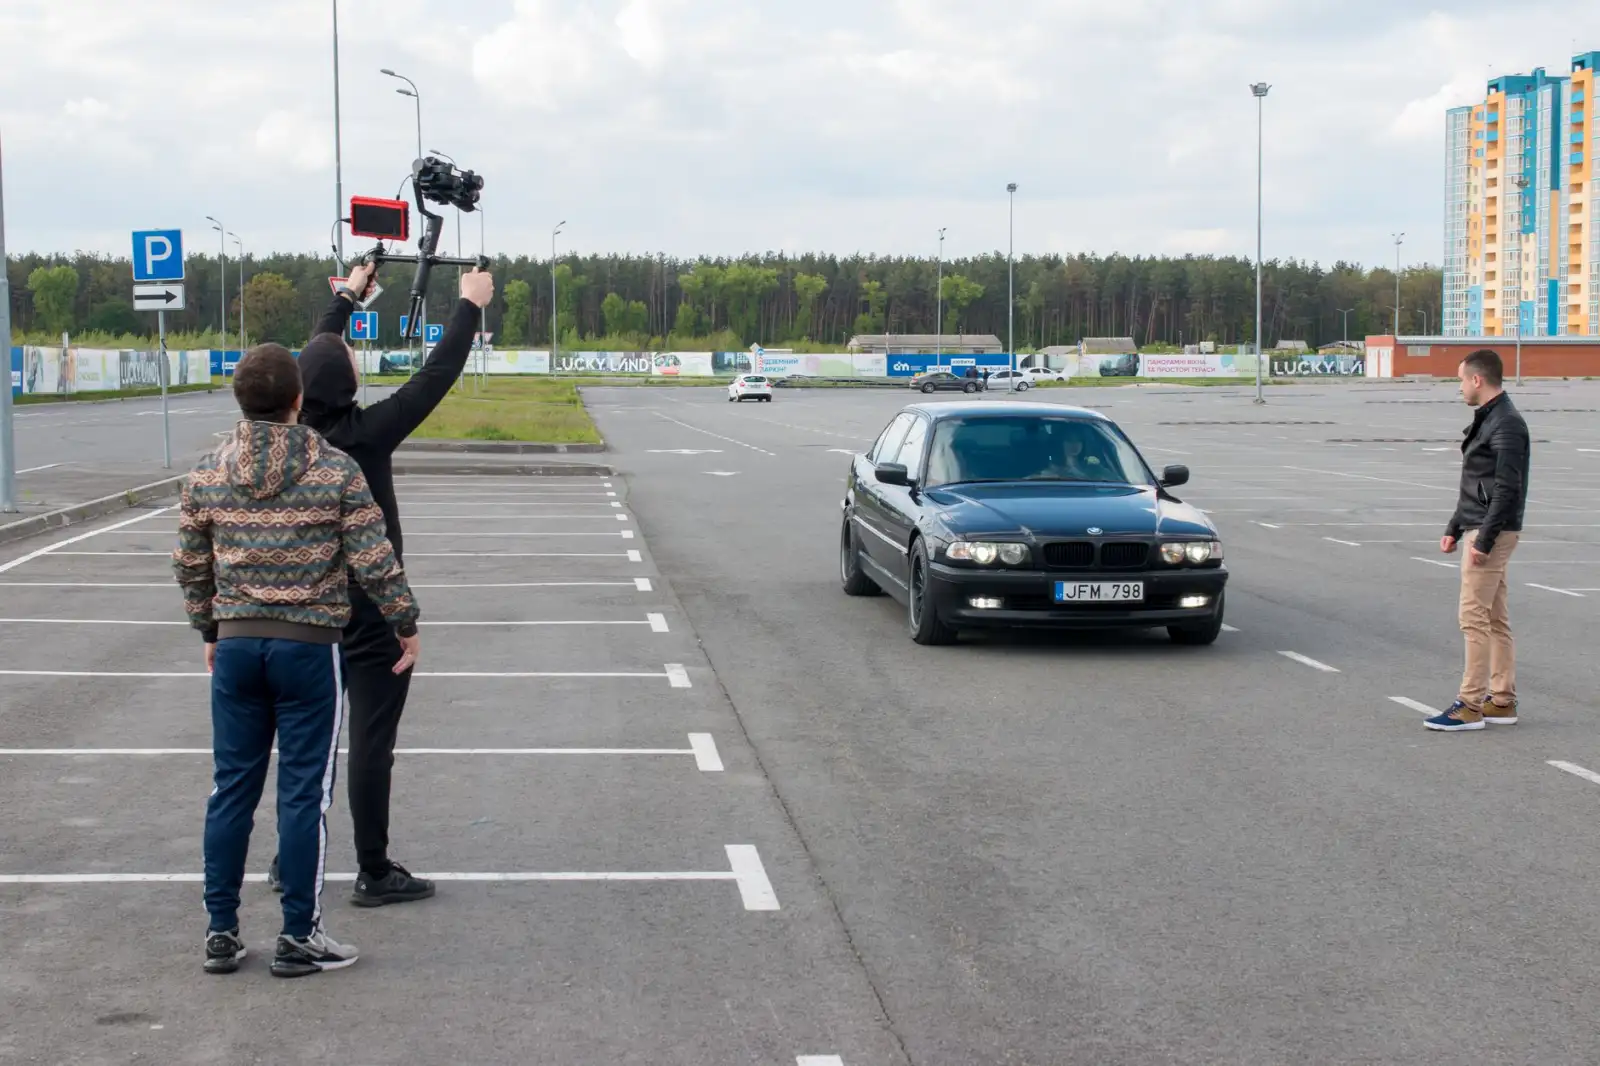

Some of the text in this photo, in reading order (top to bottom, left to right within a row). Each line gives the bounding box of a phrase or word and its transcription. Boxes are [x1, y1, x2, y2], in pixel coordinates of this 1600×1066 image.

[145, 235, 173, 275] P
[429, 326, 440, 340] P
[554, 357, 605, 371] LUCKY
[611, 358, 649, 371] LAND
[1274, 360, 1335, 375] LUCKY
[1066, 584, 1141, 599] JFM 798
